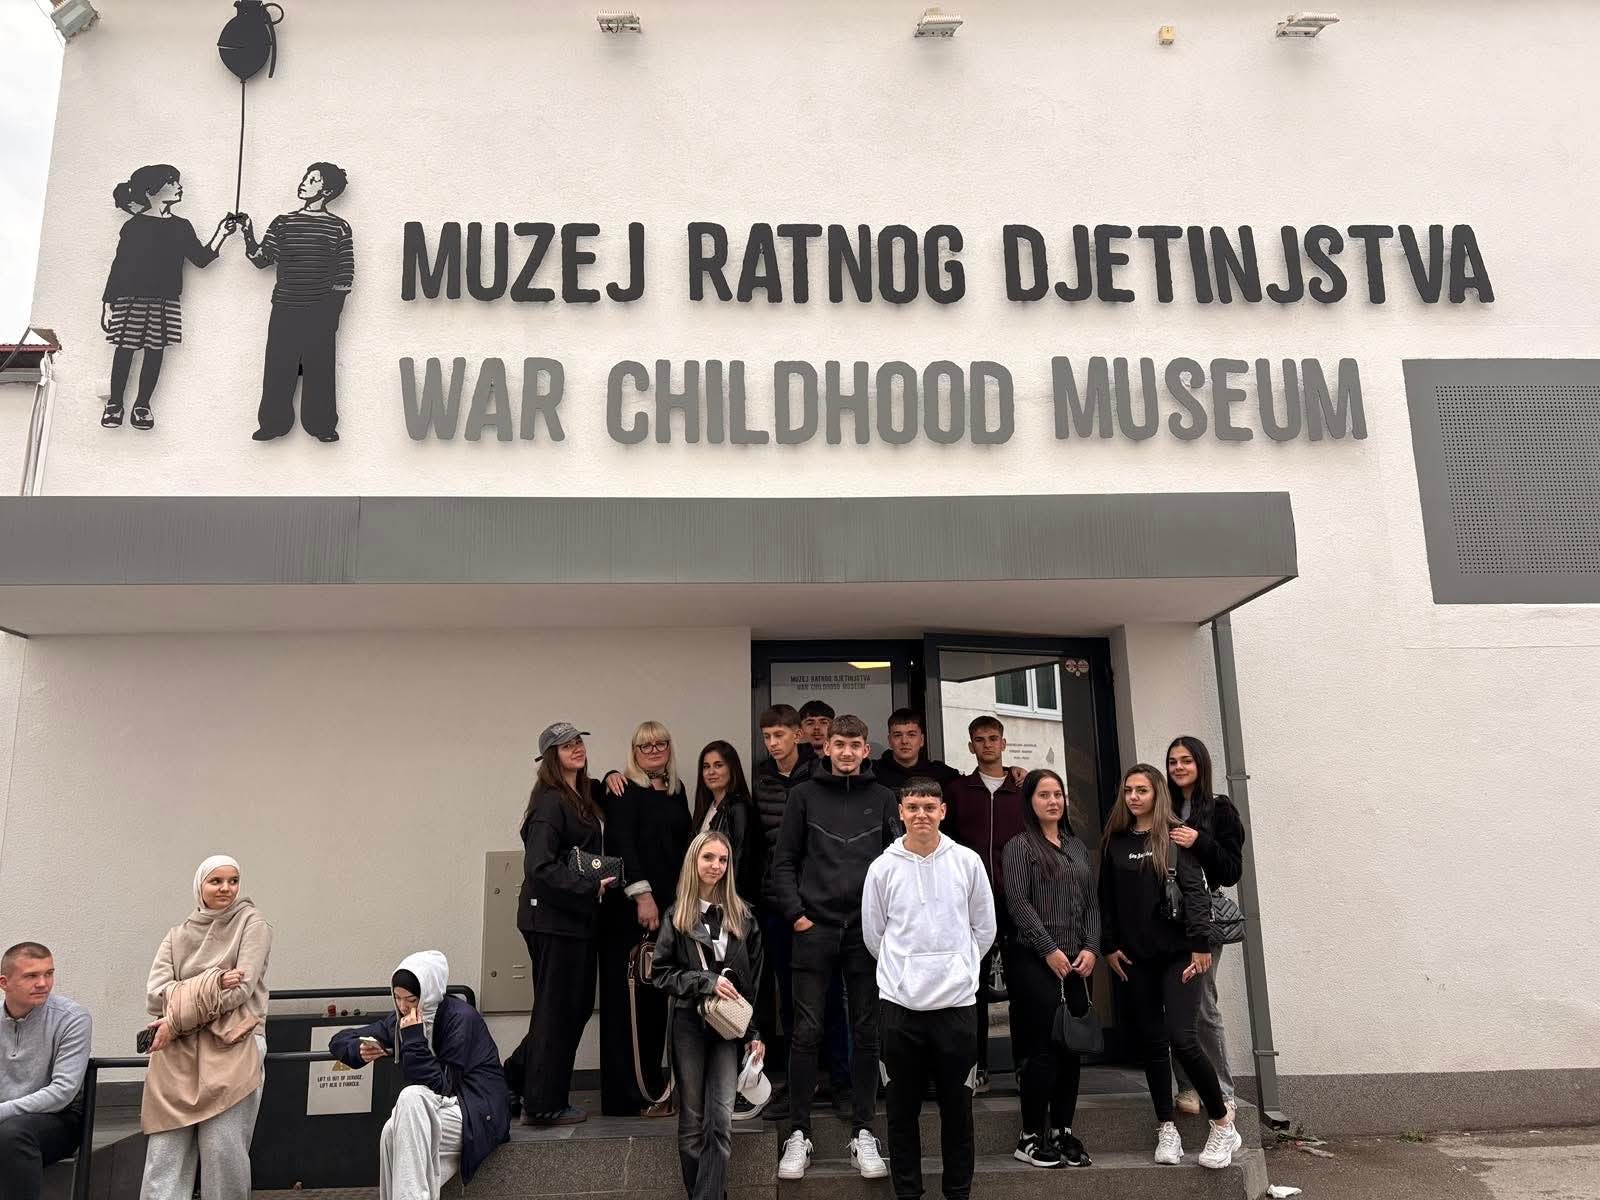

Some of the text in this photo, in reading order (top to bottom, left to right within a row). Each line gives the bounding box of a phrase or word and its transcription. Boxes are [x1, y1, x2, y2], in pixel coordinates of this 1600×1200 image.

[400, 221, 1495, 305] MUZEJ RATNOG DJETINJSTVA
[398, 356, 1368, 447] WAR CHILDHOOD MUSEUM
